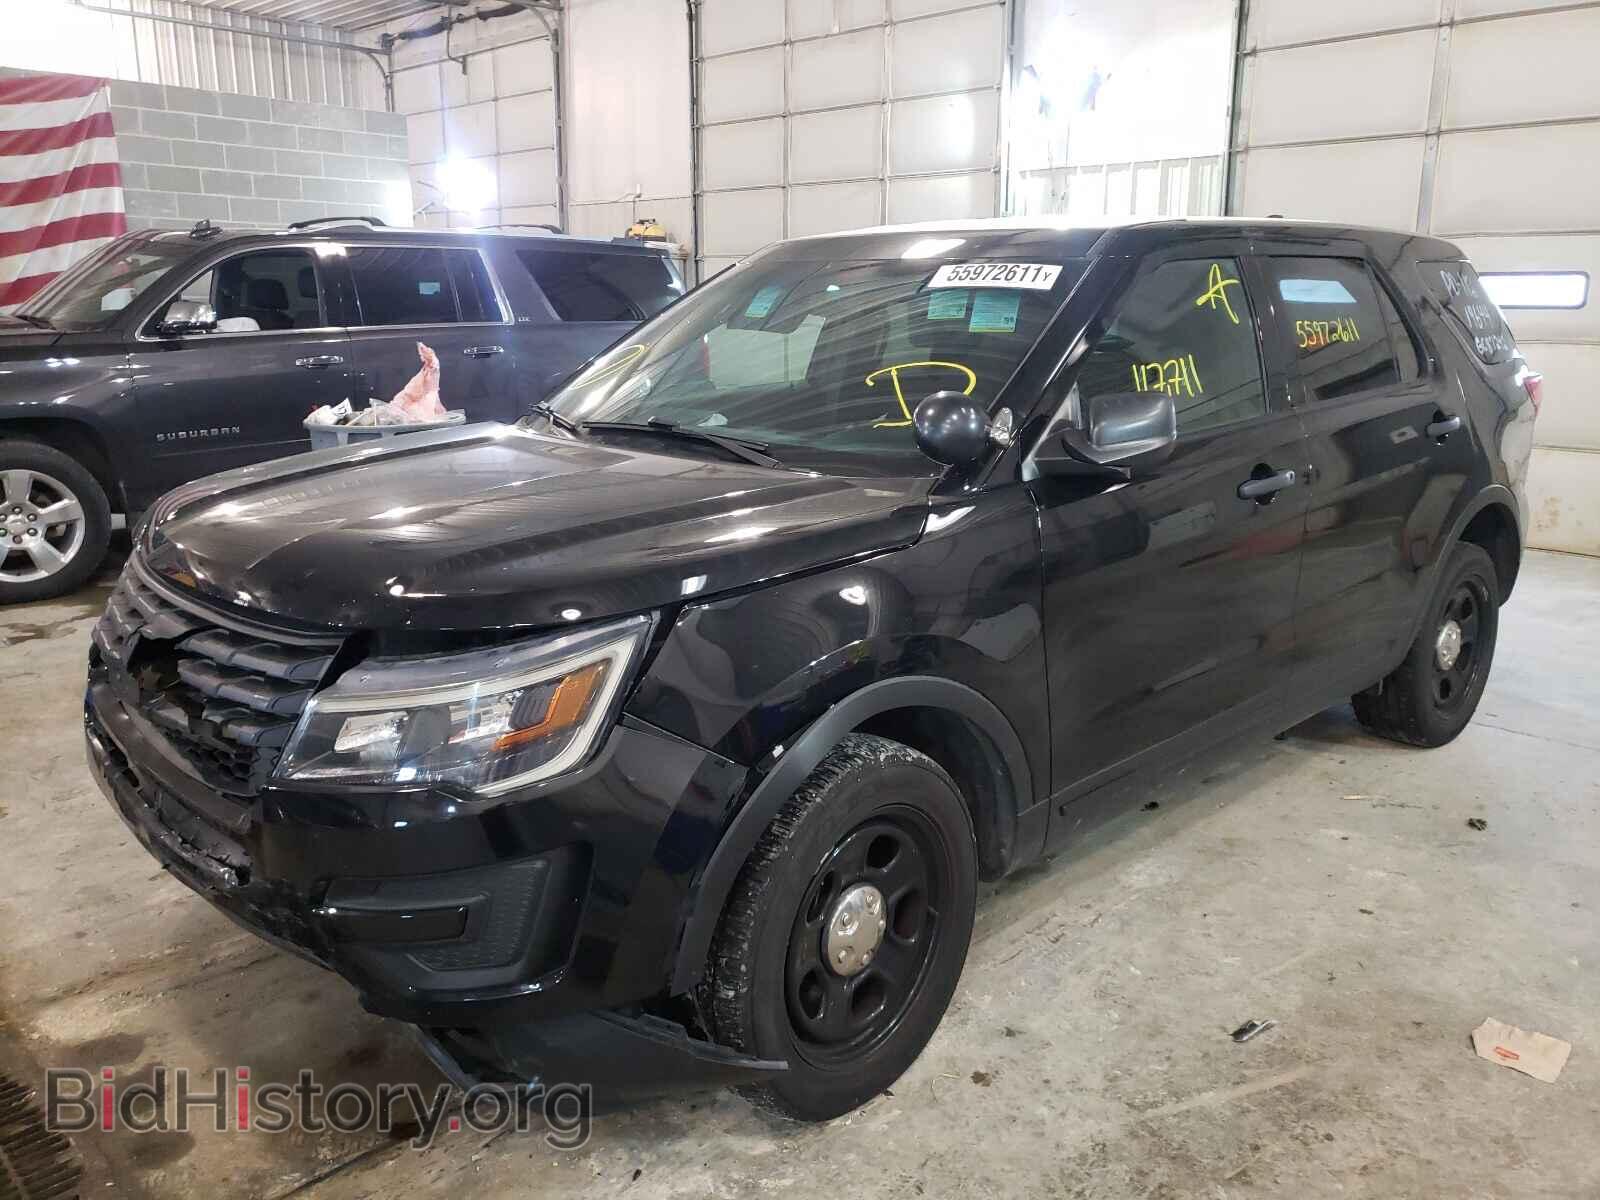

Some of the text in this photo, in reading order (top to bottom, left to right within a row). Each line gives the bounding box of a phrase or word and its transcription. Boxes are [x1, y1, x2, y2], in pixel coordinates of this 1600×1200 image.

[1195, 263, 1240, 325] A
[1295, 316, 1361, 349] 55972611
[155, 425, 241, 442] SUBURBAN
